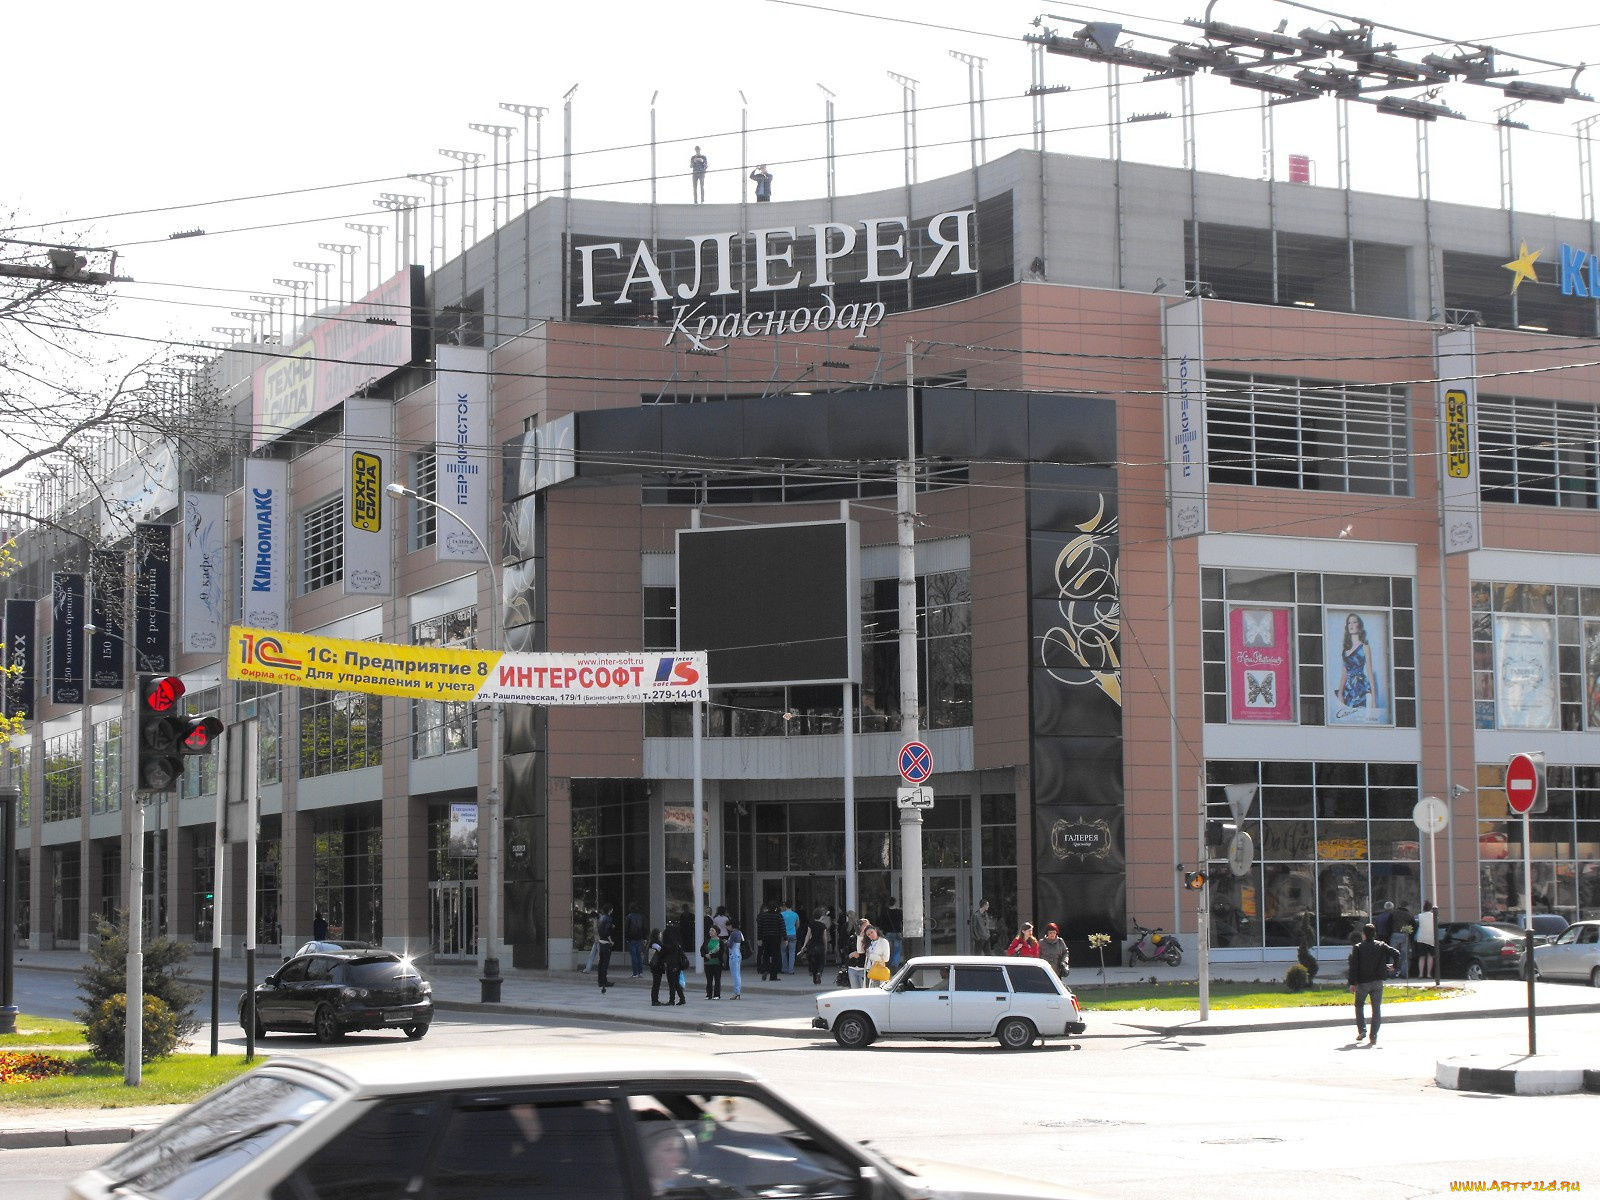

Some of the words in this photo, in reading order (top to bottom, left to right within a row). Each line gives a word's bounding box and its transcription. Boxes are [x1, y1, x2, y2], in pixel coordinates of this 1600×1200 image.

[575, 209, 979, 307] ГАЛЕРЕЯ
[665, 293, 886, 351] Краснодар
[268, 351, 313, 396] ТЕХНО
[270, 384, 308, 426] СИЛА
[1449, 397, 1458, 470] ТЕХНО
[1457, 402, 1466, 464] СИЛА
[355, 457, 366, 522] ТЕХНО
[366, 464, 377, 520] СИЛА
[251, 488, 273, 592] КИНОМАКС
[200, 553, 212, 588] кафе
[65, 587, 74, 625] брендов
[150, 568, 159, 632] ресторана
[103, 641, 112, 659] 150
[147, 636, 156, 644] 2
[241, 668, 275, 679] Фирма
[277, 673, 302, 681] «1С»
[306, 667, 333, 680] Для
[338, 672, 421, 688] управления
[425, 681, 433, 689] и
[438, 682, 475, 692] учета
[307, 647, 338, 664] 1С:
[345, 651, 471, 675] Предприятие
[477, 661, 488, 676] 8
[499, 666, 645, 688] ИНТЕРСОФТ
[577, 658, 644, 666] www.inter-soft.ru
[477, 692, 491, 700] ул.
[493, 692, 558, 702] Рашпилевская,
[652, 689, 703, 700] 279-14-01
[1064, 834, 1099, 842] ГАЛЕРЕЯ
